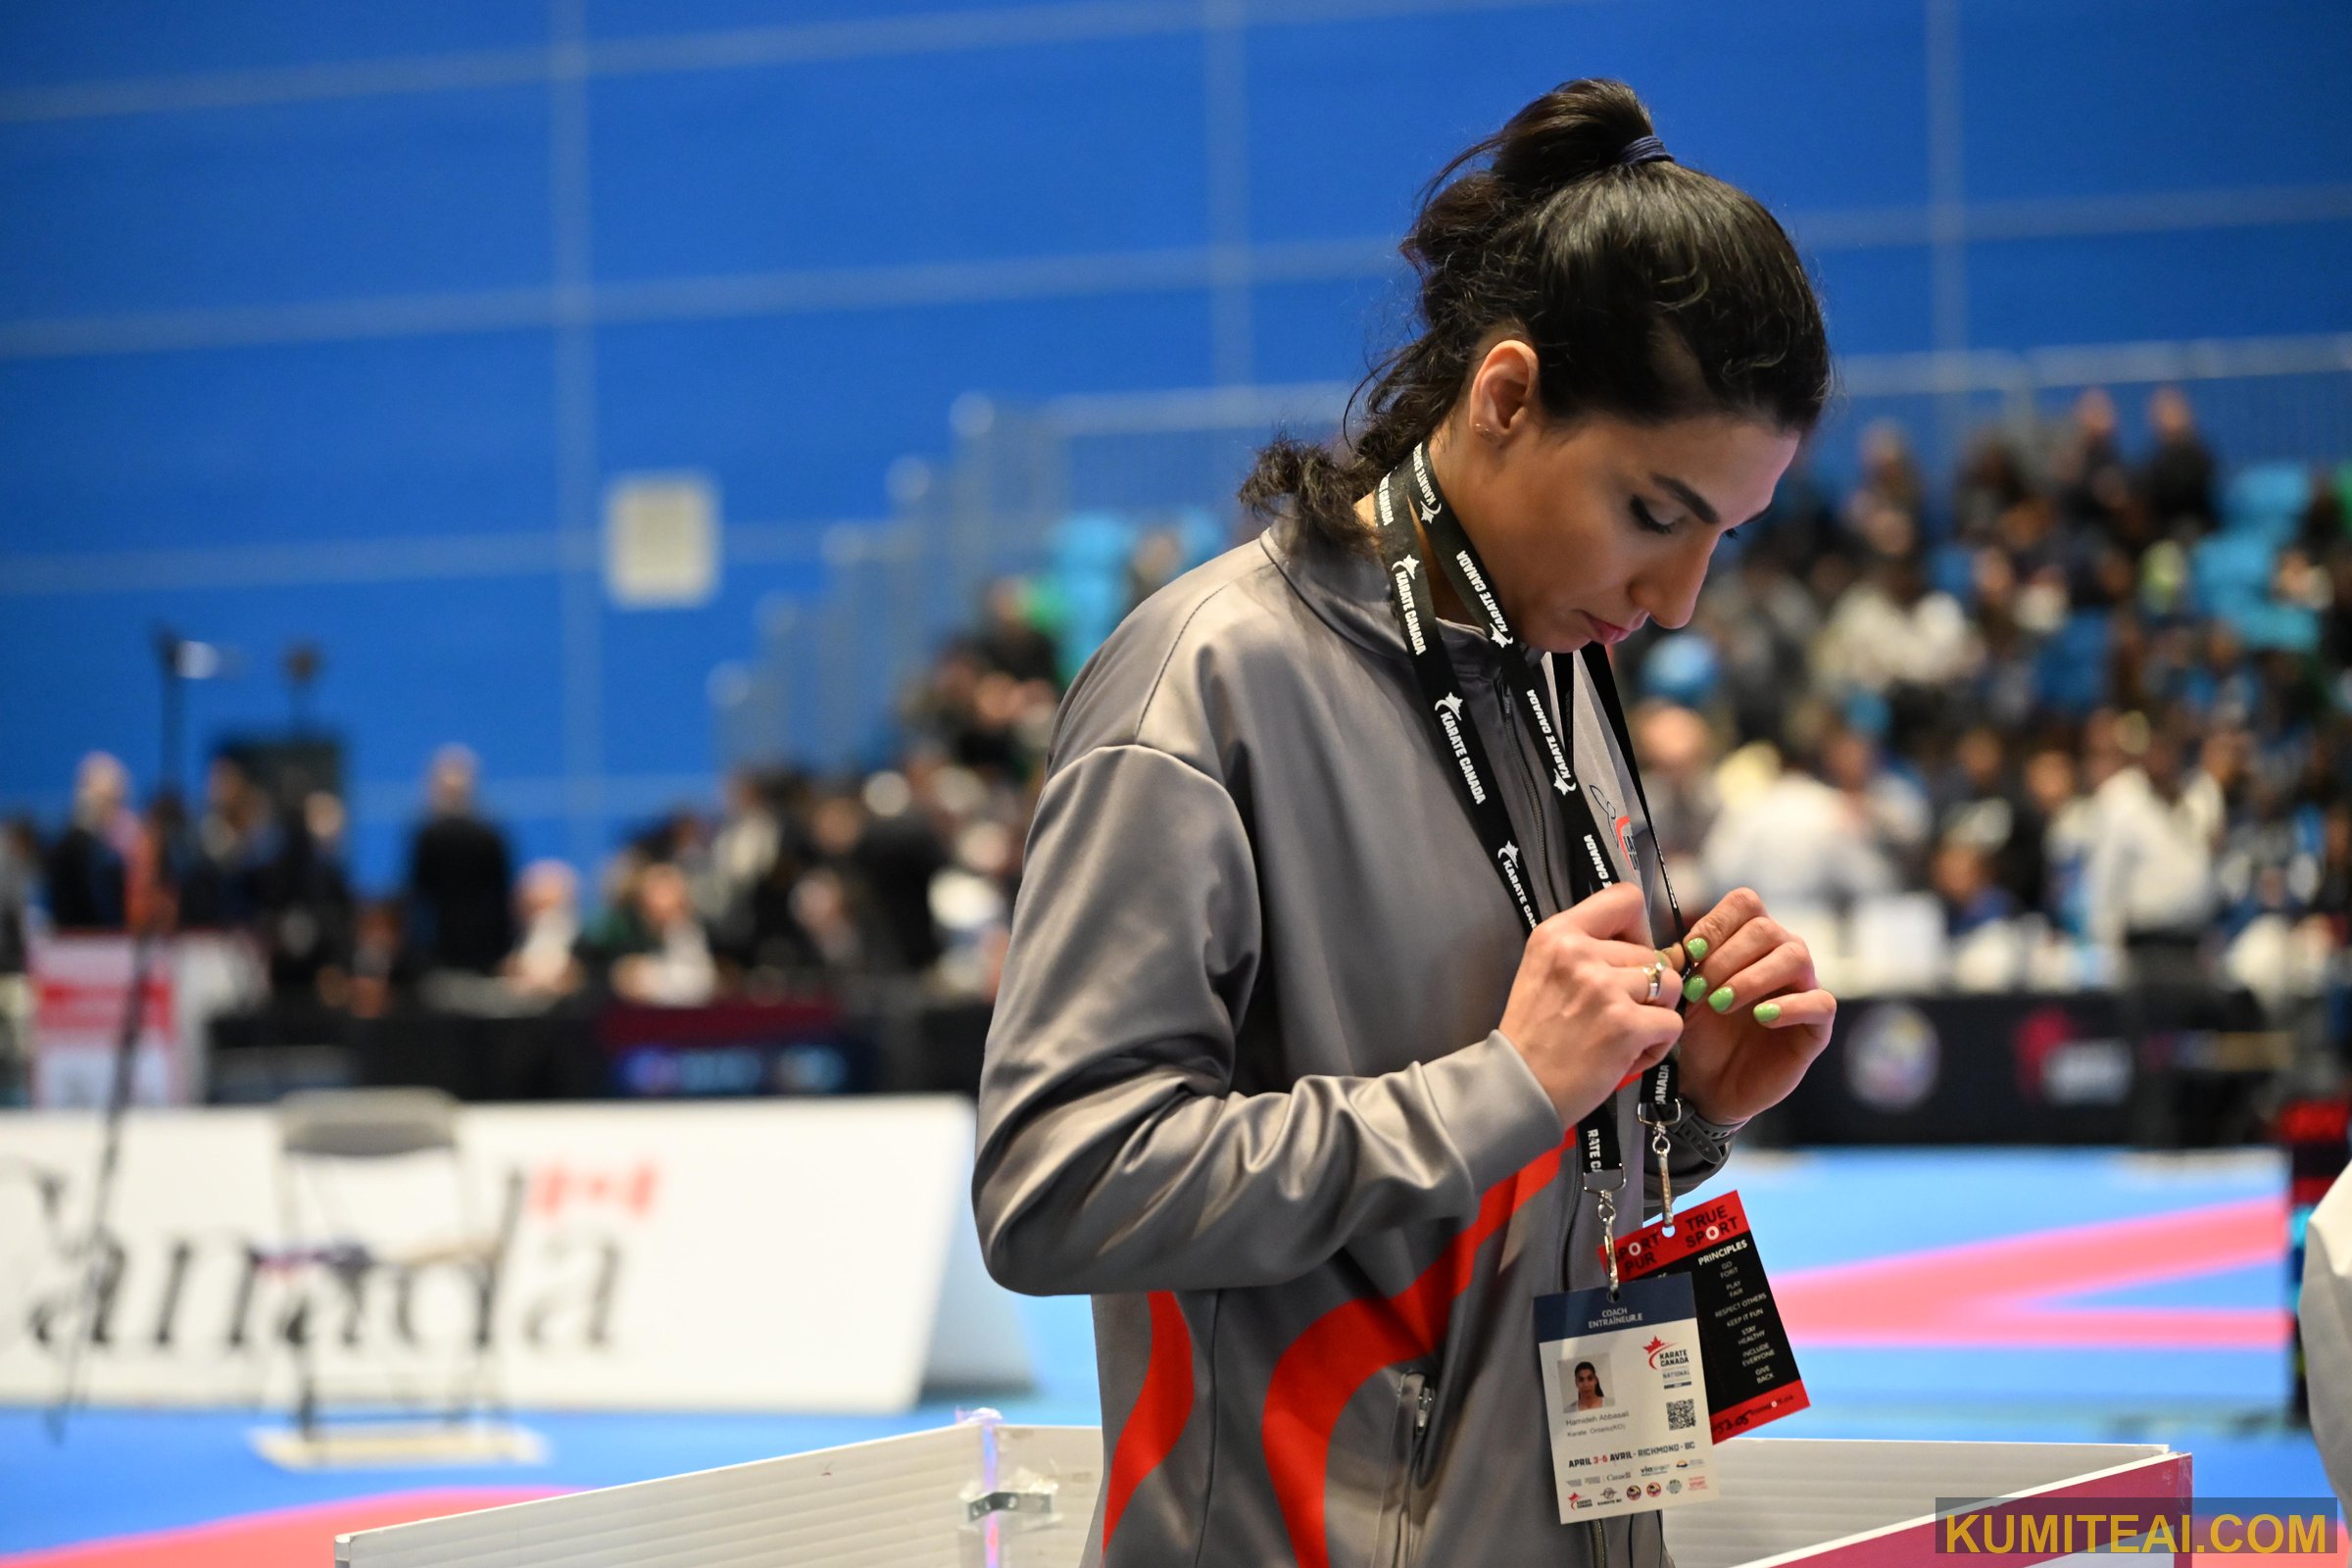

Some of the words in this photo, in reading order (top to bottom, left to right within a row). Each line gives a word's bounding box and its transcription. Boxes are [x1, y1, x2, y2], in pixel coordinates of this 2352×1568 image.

[1456, 550, 1487, 592] CANADA
[1395, 570, 1415, 611] KARATE
[1479, 591, 1508, 632] KARATE
[1404, 610, 1427, 656] CANADA
[1526, 689, 1552, 734] CANADA
[1440, 710, 1467, 758] KARATE
[1458, 757, 1487, 805] CANADA
[1544, 735, 1572, 779] KARATE
[1584, 834, 1609, 880] CANADA
[1502, 858, 1528, 905] KARATE
[1654, 1064, 1670, 1105] ANADA
[1685, 1216, 1739, 1249] SPORT
[1686, 1205, 1729, 1231] TRUE
[1624, 1251, 1656, 1273] PUR
[1697, 1239, 1748, 1266] PRINCIPLES
[1726, 1280, 1741, 1291] PLAY
[1741, 1292, 1767, 1307] OTHERS
[1601, 1307, 1628, 1318] COACH
[1726, 1316, 1742, 1327] KEEP
[1749, 1308, 1764, 1318] FUN
[1659, 1349, 1688, 1359] KARATE
[1660, 1357, 1689, 1367] CANADA
[1756, 1372, 1775, 1384] BACK
[1568, 1457, 1592, 1469] APRIL
[1609, 1450, 1634, 1462] AVRIL
[1638, 1444, 1680, 1457] RICHMOND
[1684, 1442, 1695, 1450] BC
